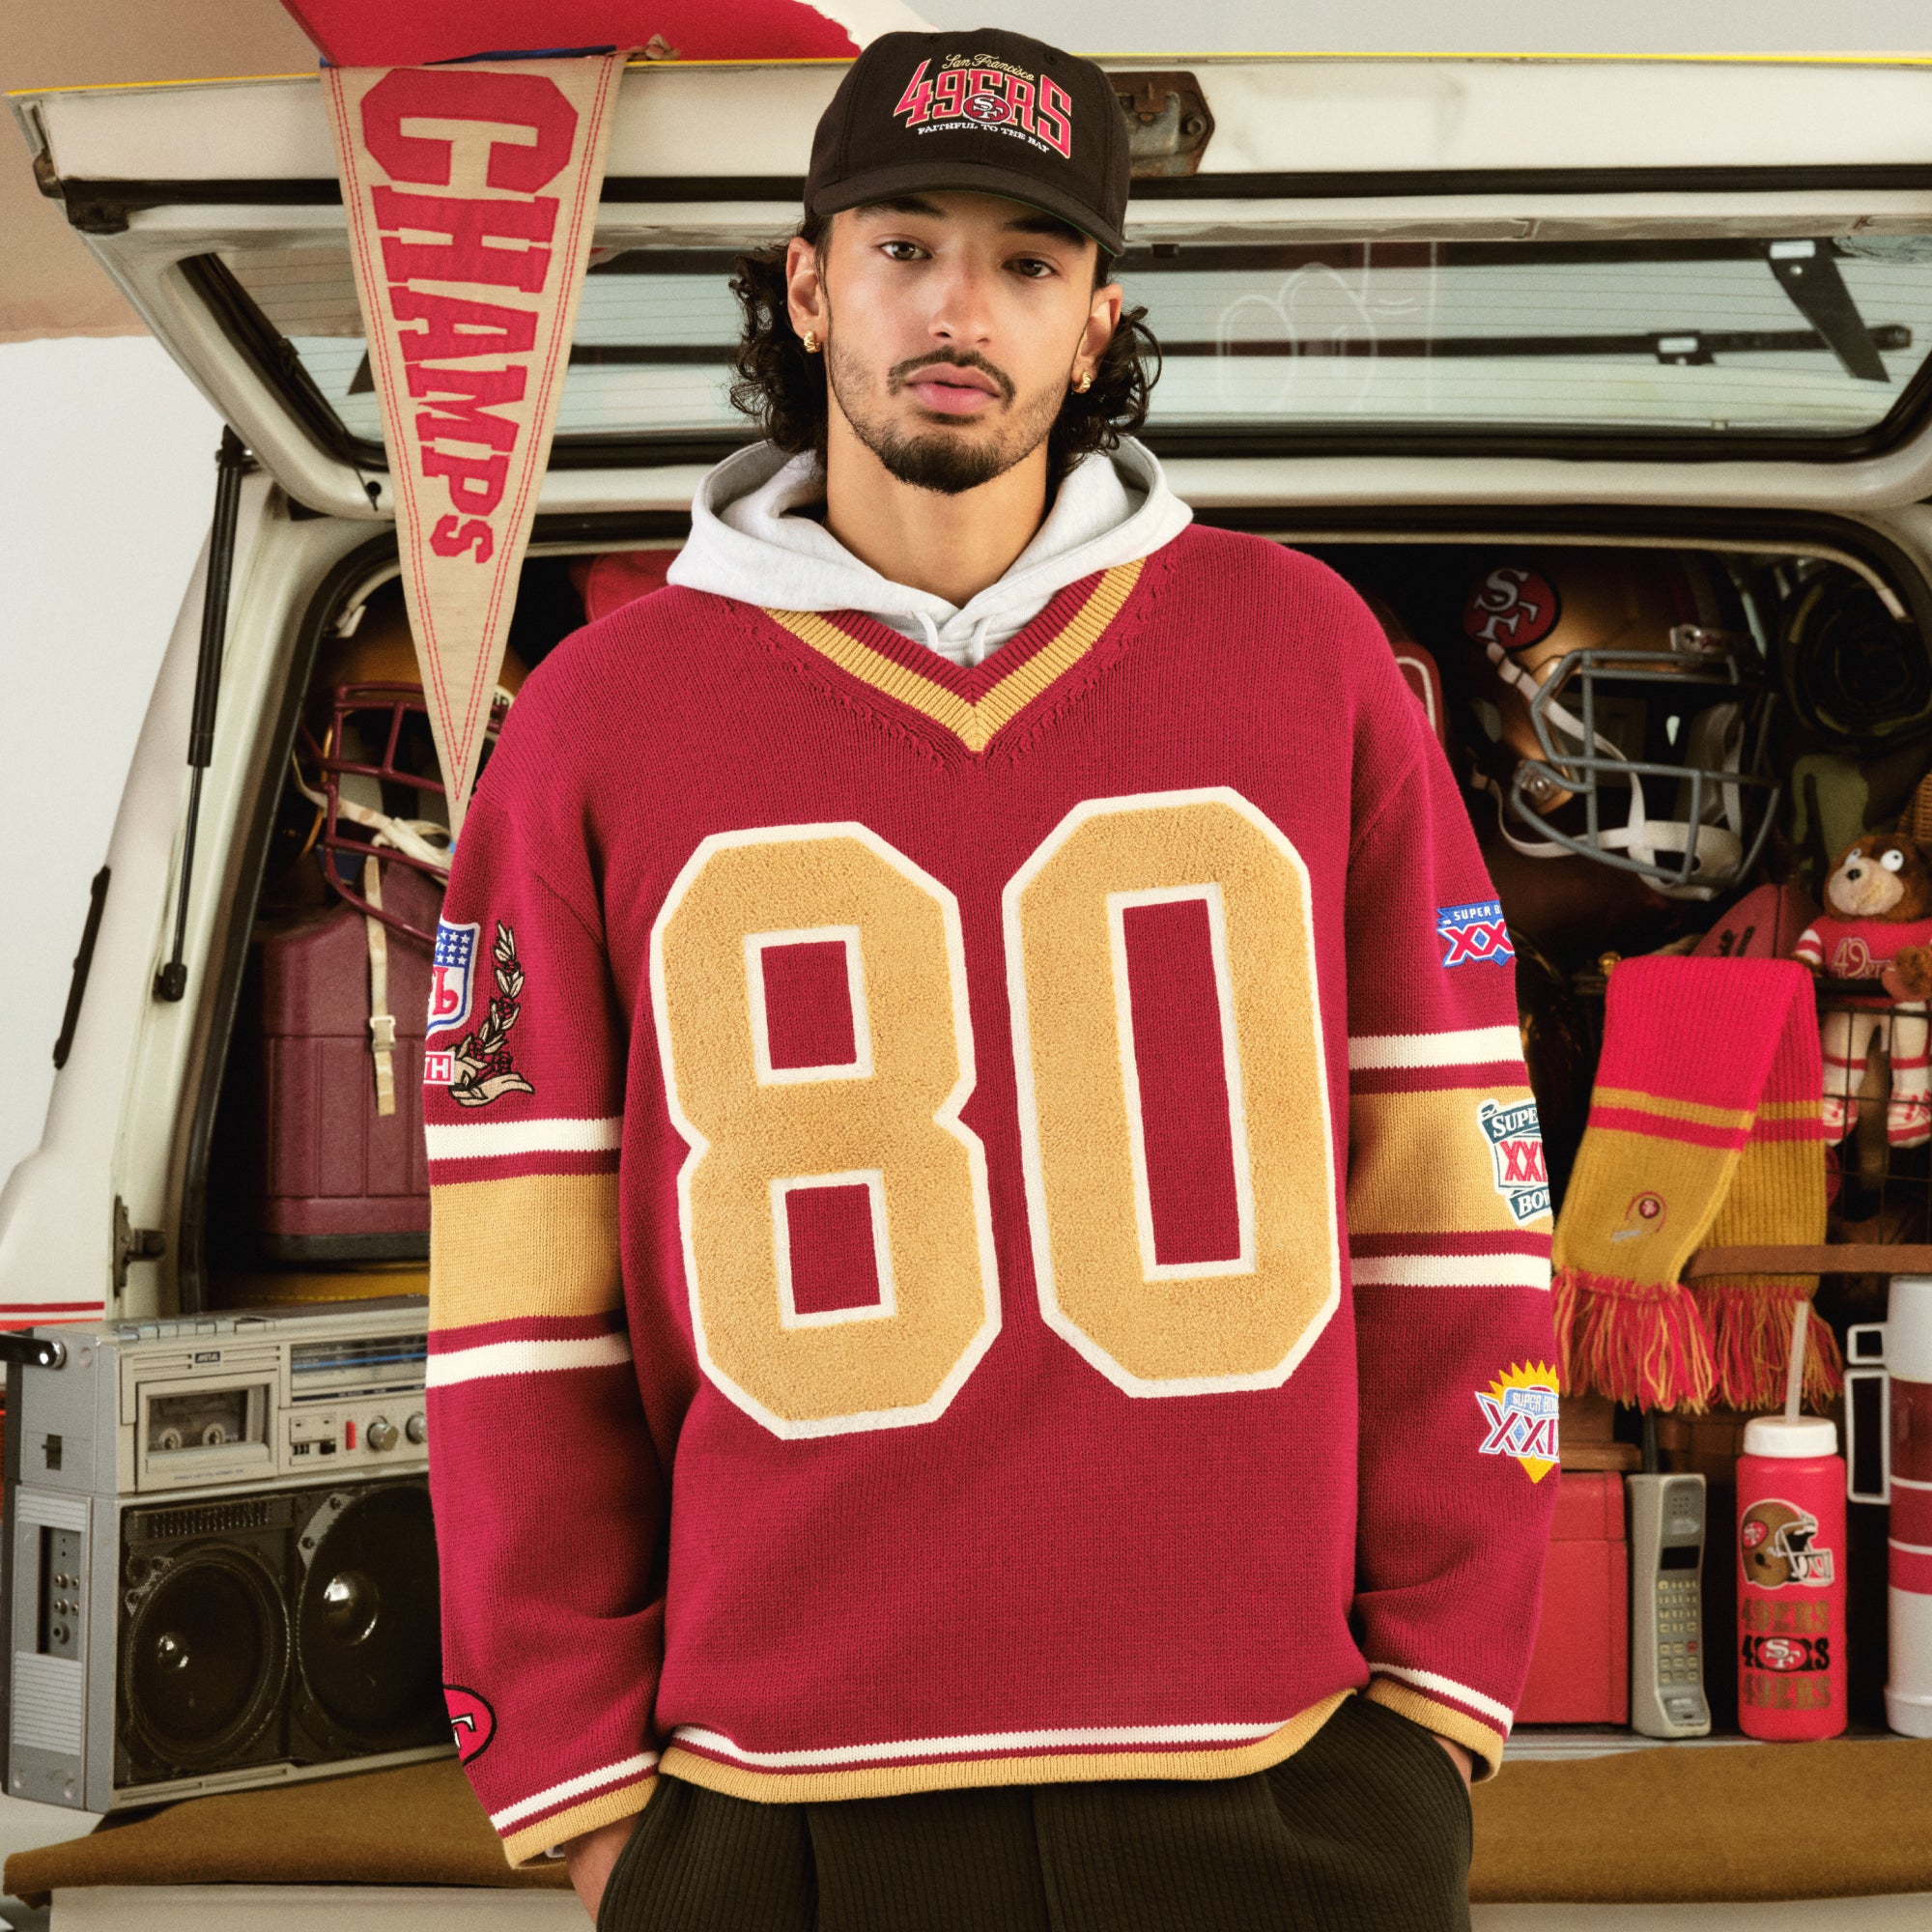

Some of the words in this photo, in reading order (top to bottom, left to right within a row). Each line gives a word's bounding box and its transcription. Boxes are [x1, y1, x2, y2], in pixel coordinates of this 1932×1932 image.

[942, 54, 972, 70] San
[972, 54, 1035, 81] Francisco
[893, 58, 1072, 158] 49ERS
[973, 97, 1004, 119] SF
[918, 123, 979, 135] FAITHFUL
[980, 124, 998, 132] TO
[1001, 128, 1026, 140] THE
[1028, 135, 1050, 154] BAY
[360, 68, 579, 565] CHAMPS
[1474, 568, 1539, 641] SF
[1453, 905, 1492, 921] SUPER
[1493, 904, 1503, 915] B
[650, 785, 1341, 1440] 80
[1512, 1392, 1542, 1413] SUPER
[1481, 1397, 1559, 1458] XXI
[1742, 1599, 1830, 1634] 49ERS
[1766, 1639, 1801, 1669] SF
[1745, 1674, 1831, 1710] 49ERS
